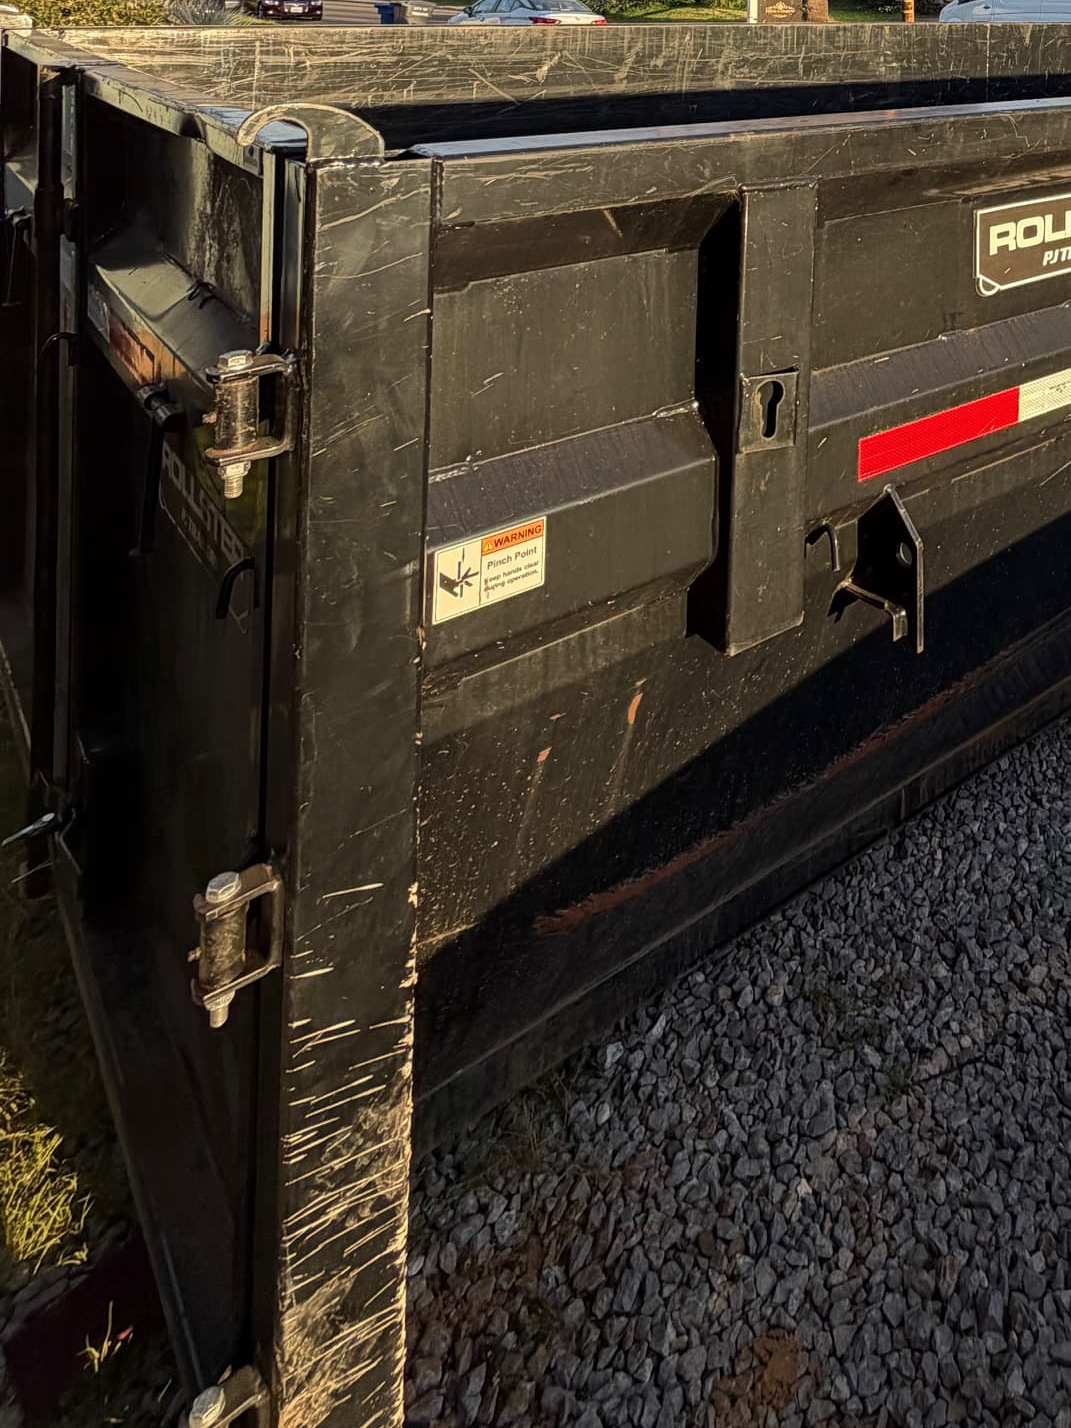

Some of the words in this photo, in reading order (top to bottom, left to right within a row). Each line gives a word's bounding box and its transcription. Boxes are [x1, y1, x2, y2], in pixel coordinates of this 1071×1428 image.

[1043, 249, 1060, 266] PJ
[163, 440, 244, 564] ROLLSTER
[494, 525, 542, 547] WARNING
[487, 556, 513, 570] Pinch
[515, 546, 537, 560] Point
[503, 567, 522, 577] hands
